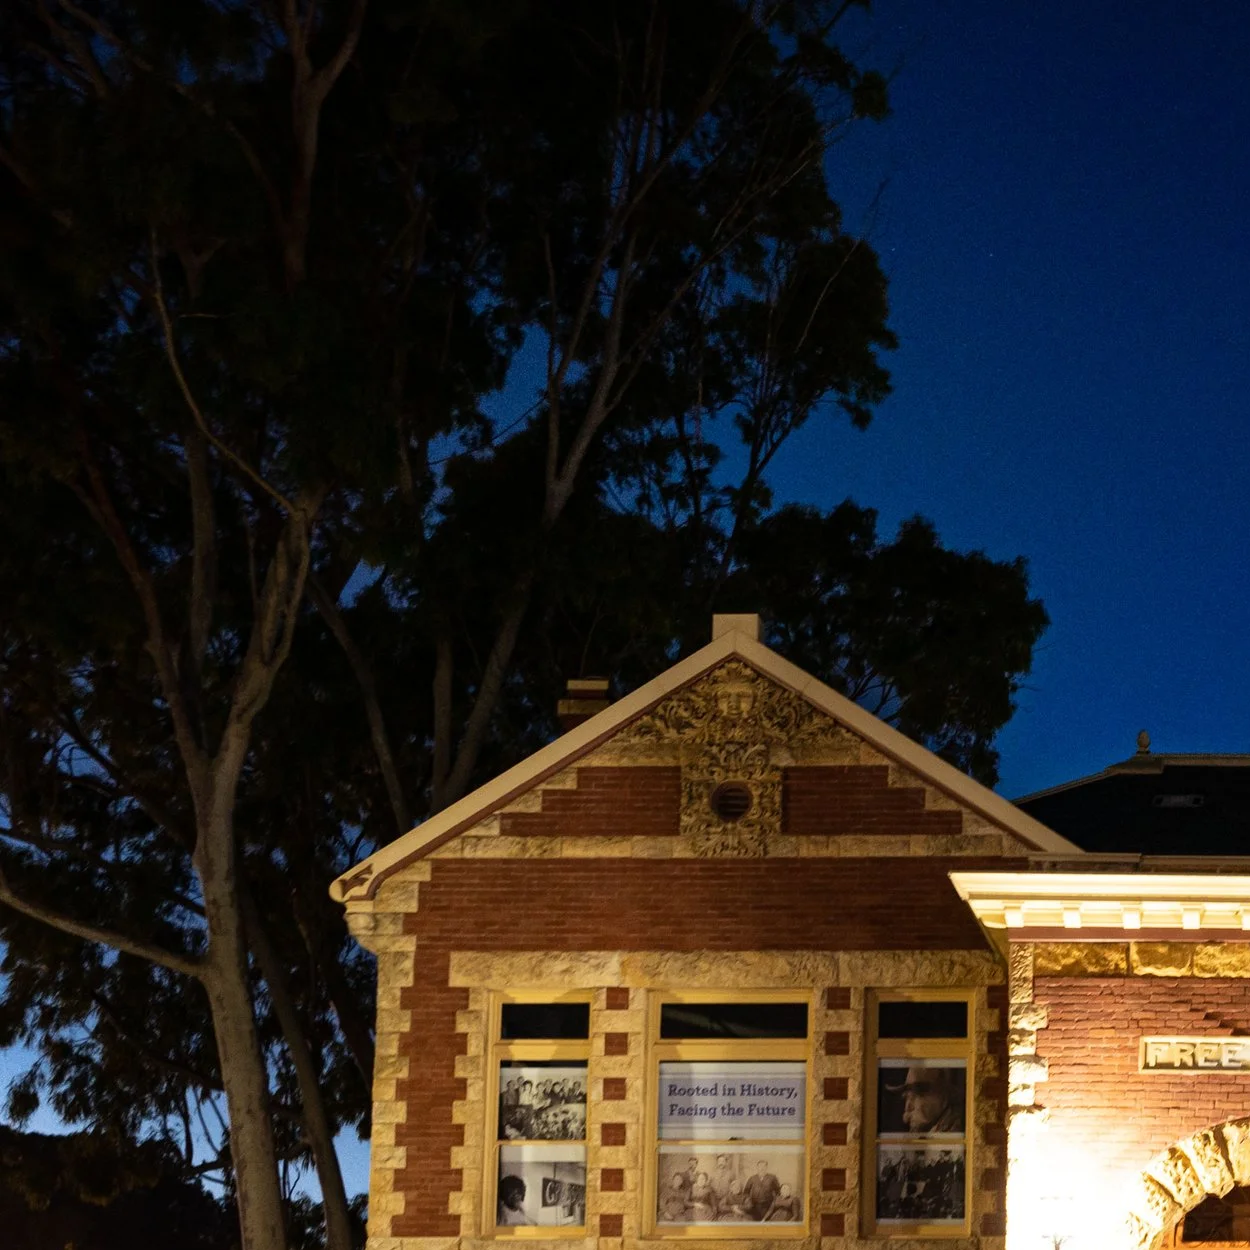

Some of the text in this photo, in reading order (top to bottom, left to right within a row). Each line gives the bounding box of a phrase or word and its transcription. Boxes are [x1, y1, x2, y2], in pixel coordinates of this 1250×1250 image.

[1147, 1041, 1244, 1068] FREE
[668, 1082, 798, 1099] Rooted in History,
[669, 1103, 796, 1119] Facing the Future
